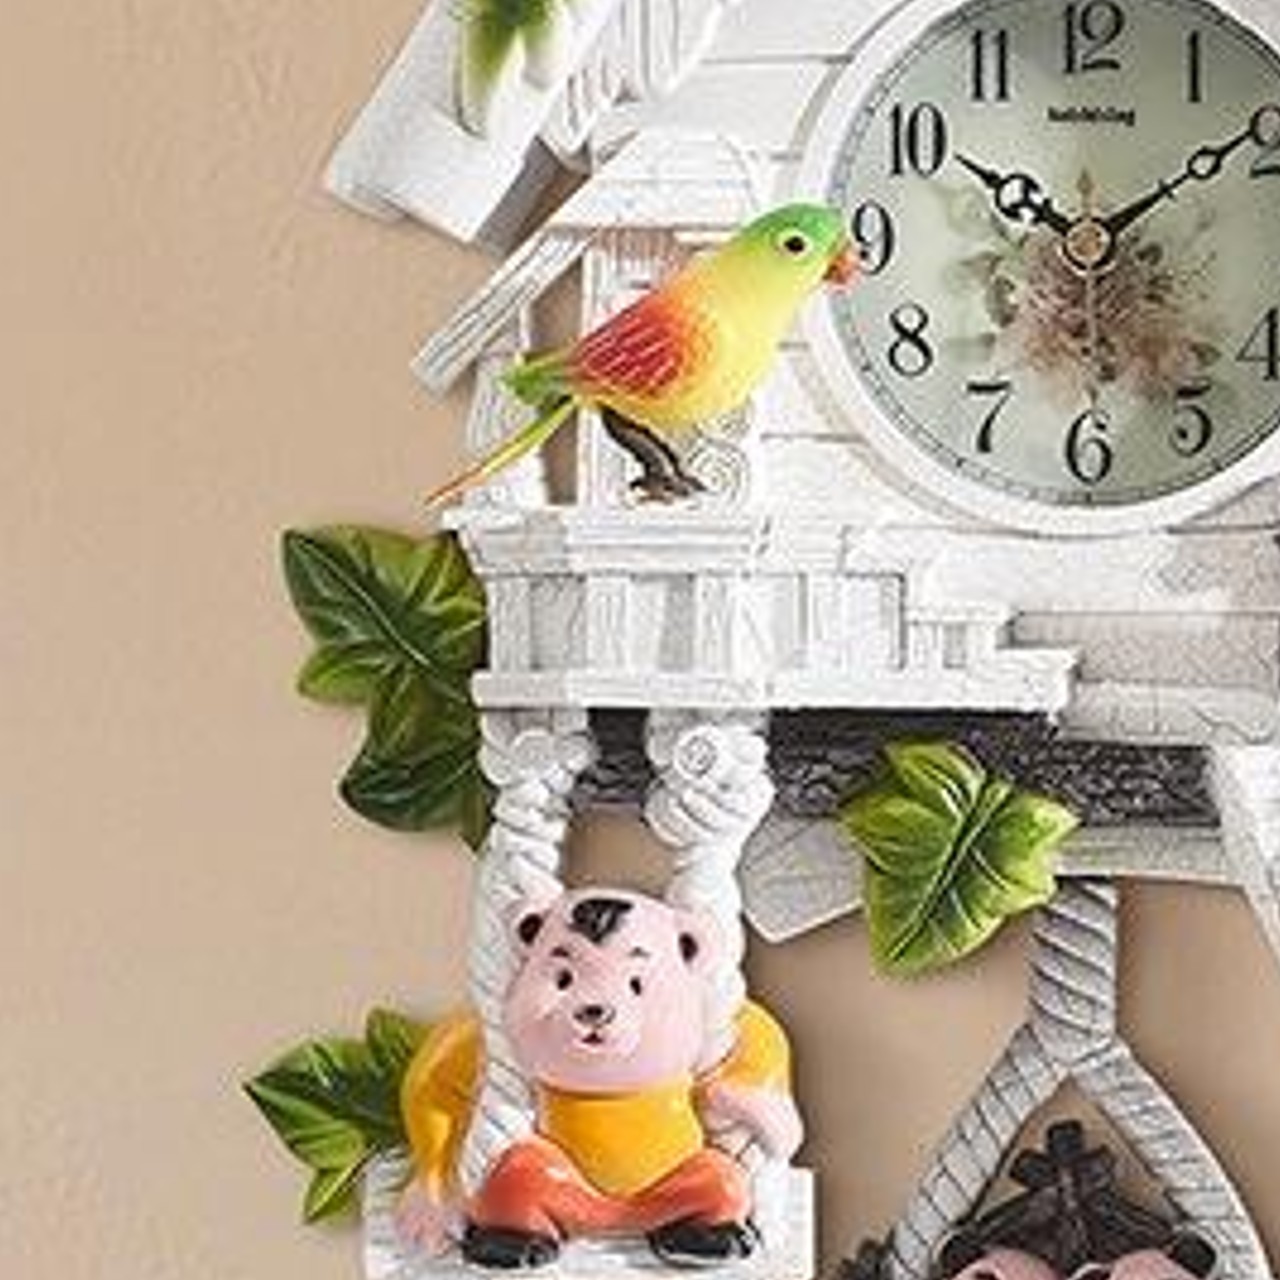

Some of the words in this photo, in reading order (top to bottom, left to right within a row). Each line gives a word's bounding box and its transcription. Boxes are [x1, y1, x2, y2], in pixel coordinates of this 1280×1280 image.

[969, 29, 1010, 102] 11
[1183, 30, 1202, 104] 1
[888, 102, 947, 177] 10
[852, 202, 895, 276] 9
[887, 304, 933, 377] 8
[966, 381, 1012, 453] 7
[1065, 408, 1113, 484] 6
[1167, 384, 1213, 457] 5
